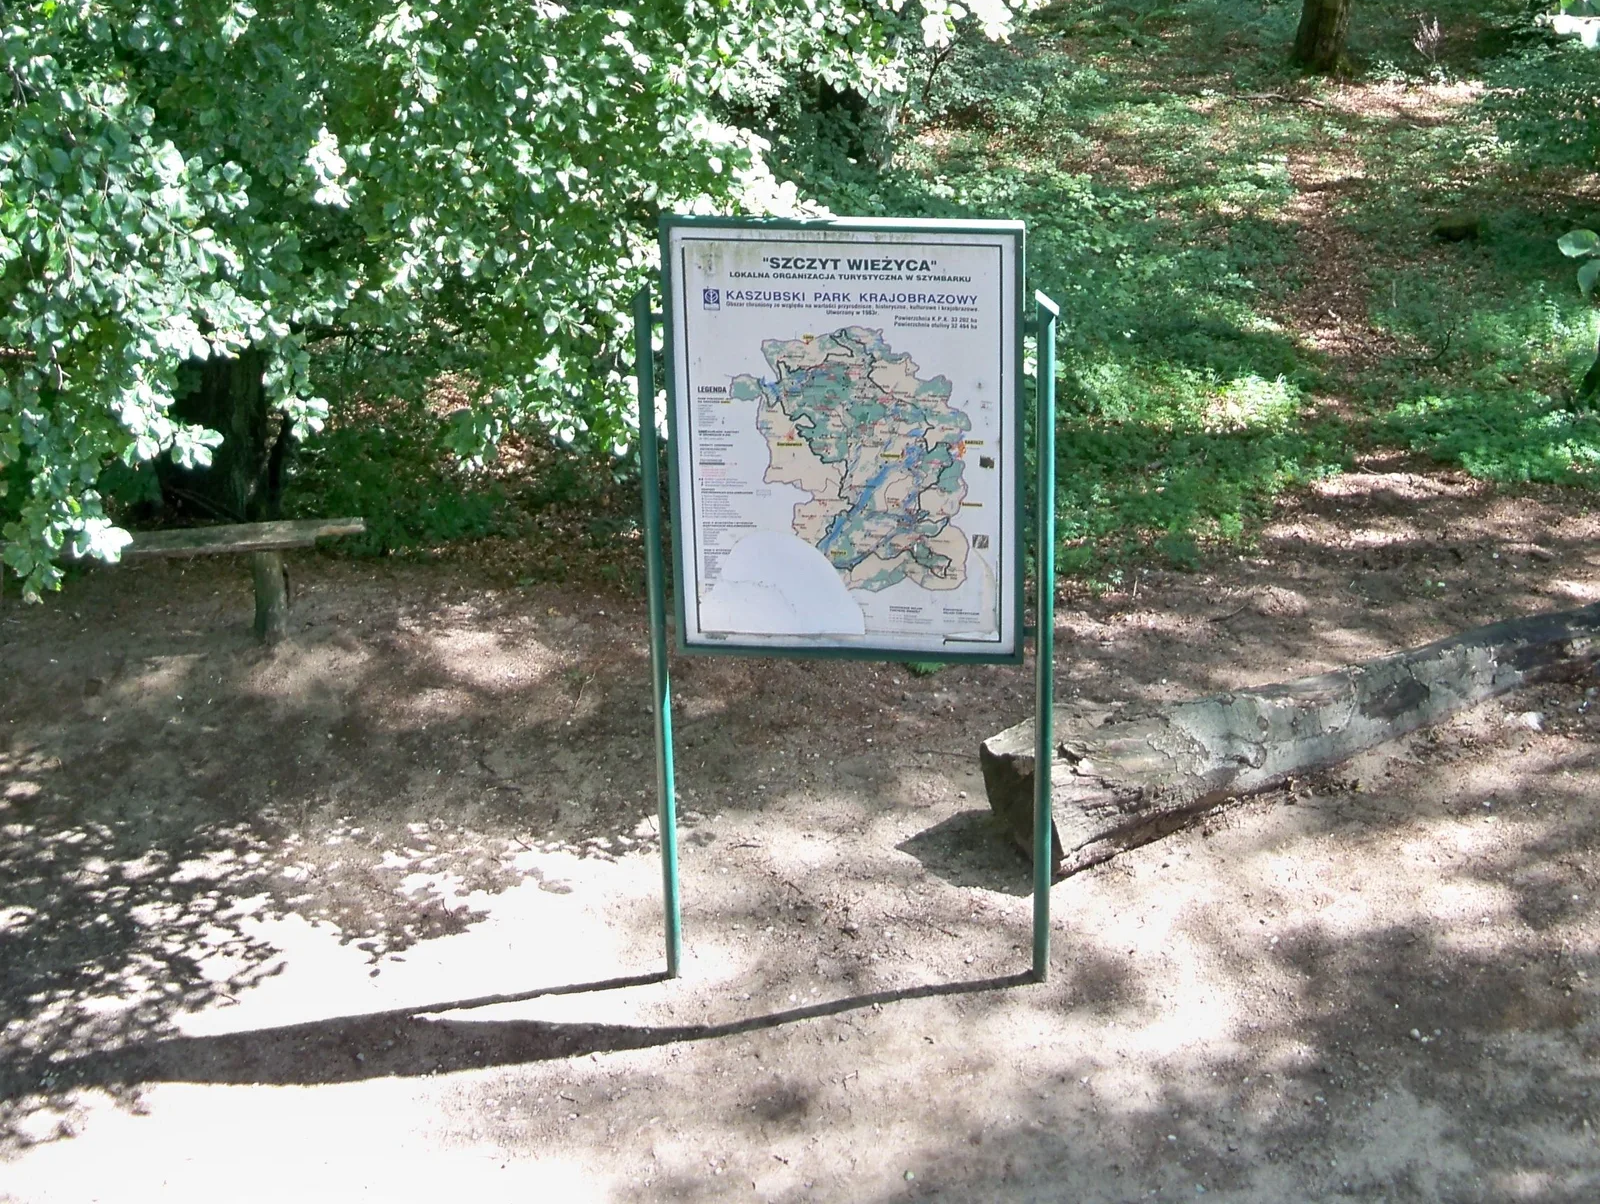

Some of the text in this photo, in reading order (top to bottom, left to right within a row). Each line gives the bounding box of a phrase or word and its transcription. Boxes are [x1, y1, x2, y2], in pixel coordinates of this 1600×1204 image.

[762, 256, 937, 272] "SZCZYT WIEŻYCA"
[729, 271, 770, 279] LOKALNA
[772, 272, 836, 280] ORGANIZACJA
[838, 273, 902, 281] TURYSTYCZNA
[916, 275, 971, 283] SZYMBARKU
[726, 290, 978, 305] KASZUBSKI PARK KRAJOBRAZOWY
